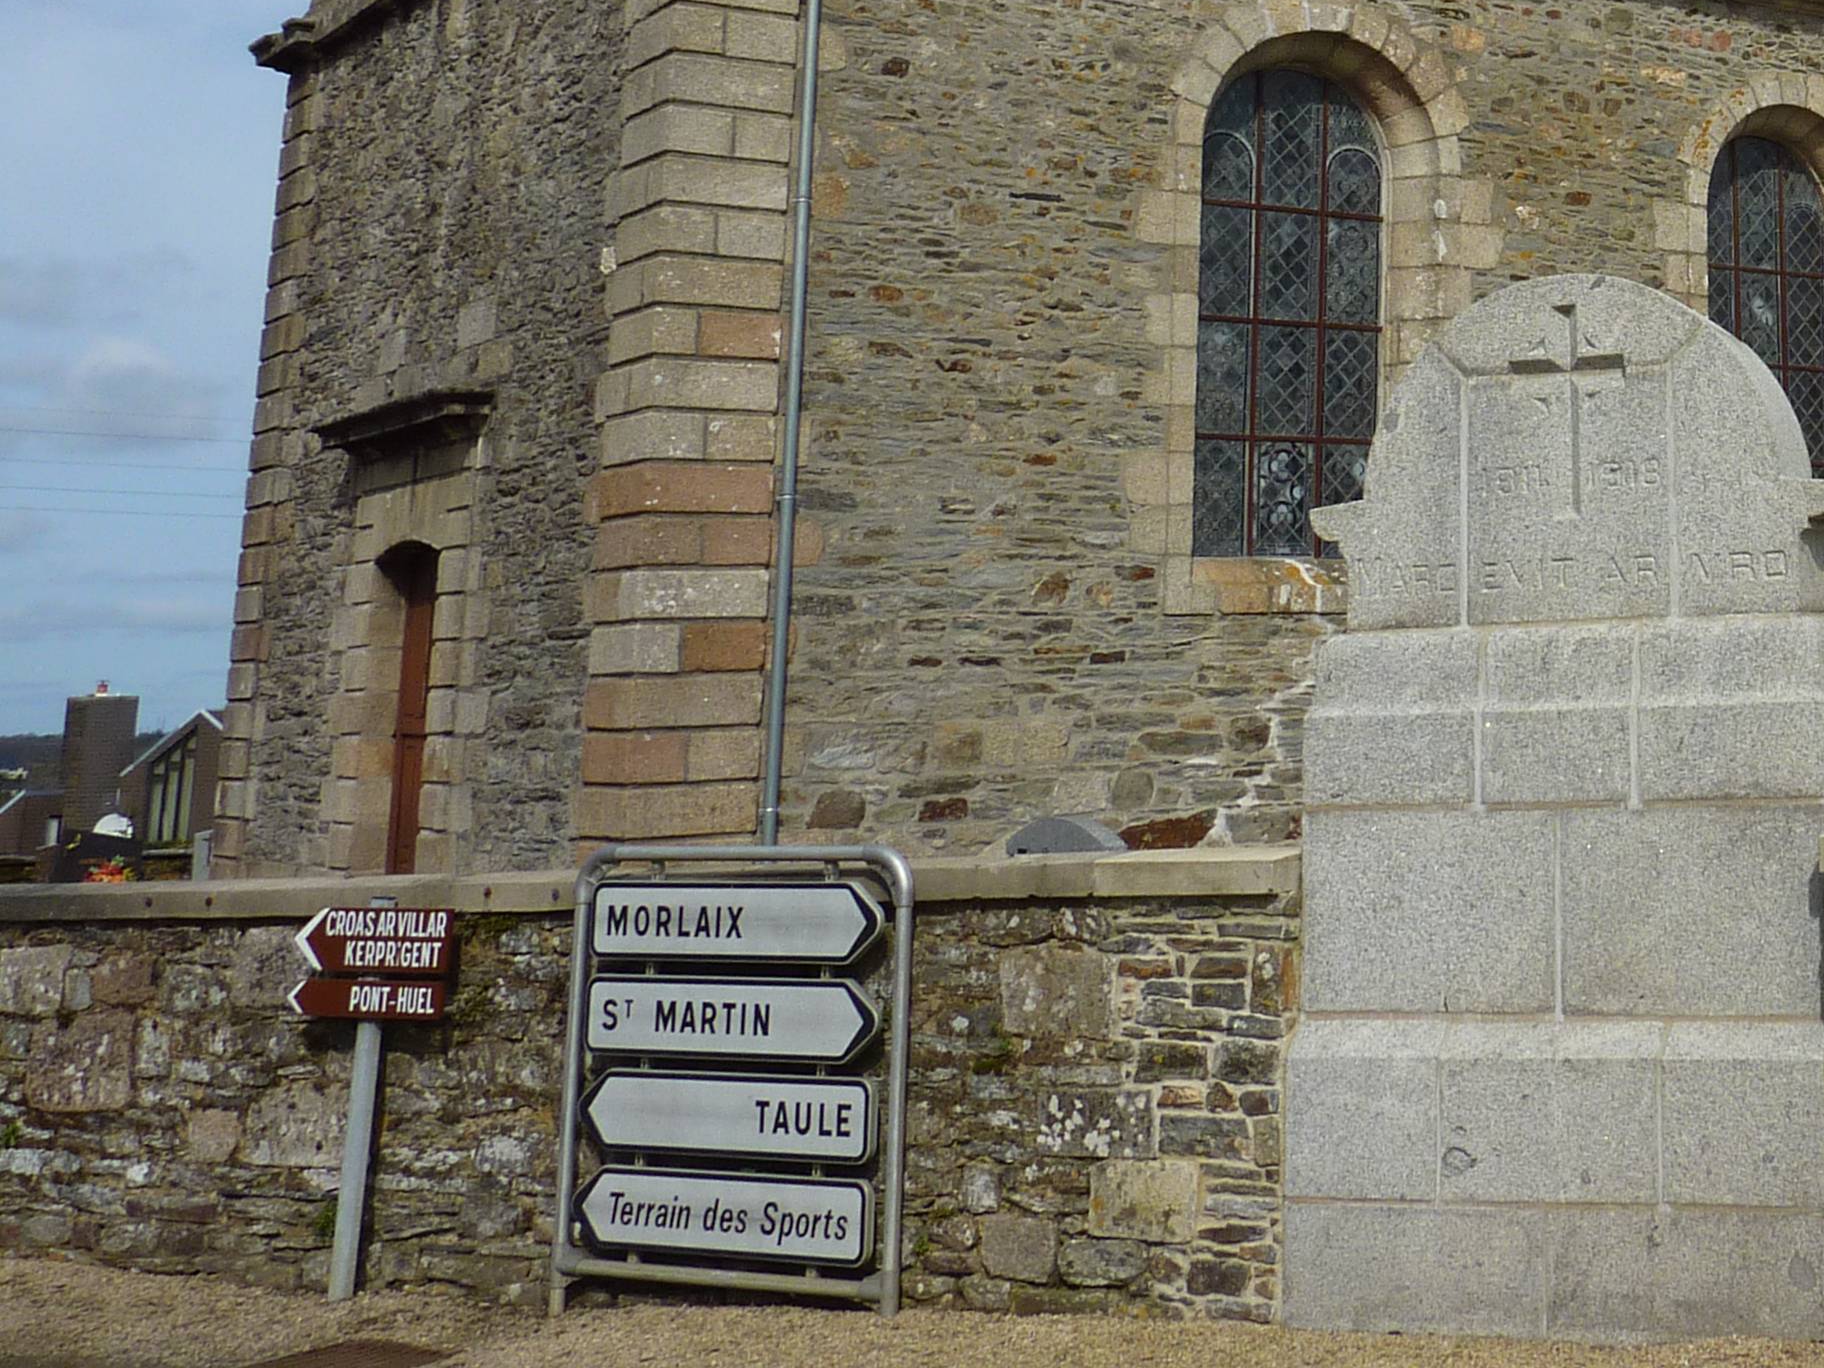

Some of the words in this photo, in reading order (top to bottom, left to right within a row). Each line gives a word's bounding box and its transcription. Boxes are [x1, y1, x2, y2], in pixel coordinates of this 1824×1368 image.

[325, 910, 376, 937] CROAS
[376, 911, 396, 938] AR
[399, 911, 448, 939] VILLAR
[606, 904, 744, 939] MORLAIX
[348, 985, 435, 1015] PONT-HUEL
[602, 998, 635, 1031] ST
[654, 999, 771, 1037] MARTIN
[755, 1099, 853, 1138] TAULE
[608, 1191, 692, 1231] Terrain
[702, 1197, 749, 1234] des
[759, 1201, 849, 1247] Sports
